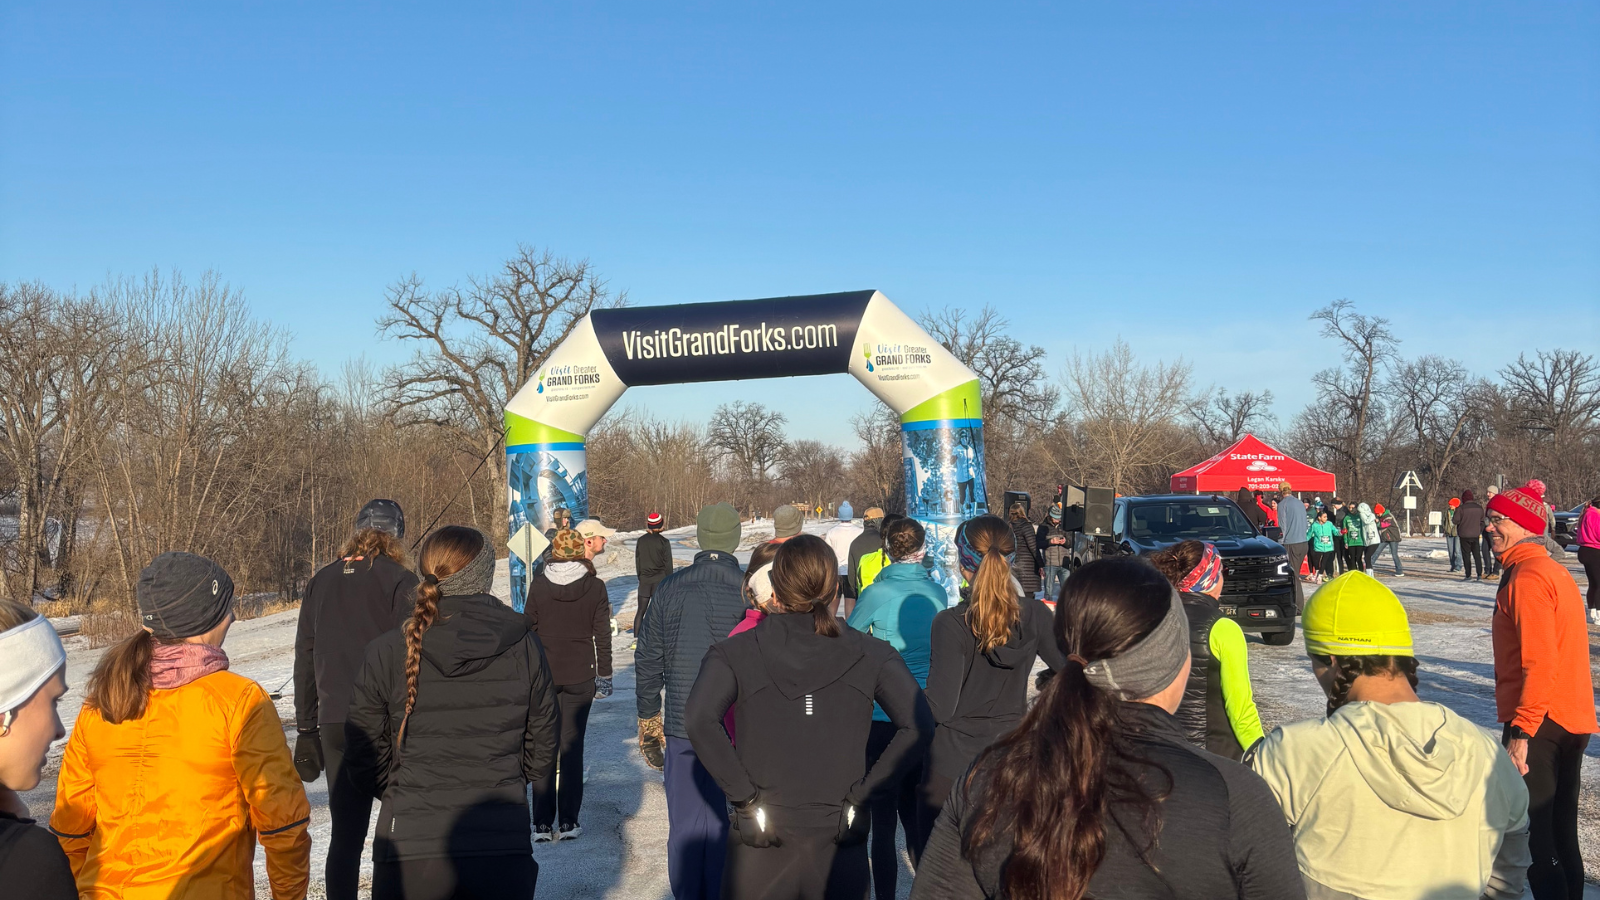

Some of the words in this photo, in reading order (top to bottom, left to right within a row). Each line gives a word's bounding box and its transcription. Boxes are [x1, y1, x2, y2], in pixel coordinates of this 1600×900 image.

[622, 322, 838, 360] VisitGrandForks.com
[877, 343, 901, 354] Visit
[904, 345, 927, 354] Greater
[875, 355, 904, 366] GRAND
[905, 353, 932, 364] FORKS
[550, 365, 571, 375] Visit
[573, 364, 597, 374] Greater
[546, 375, 573, 387] GRAND
[574, 373, 601, 385] FORKS
[1258, 453, 1285, 461] Farm
